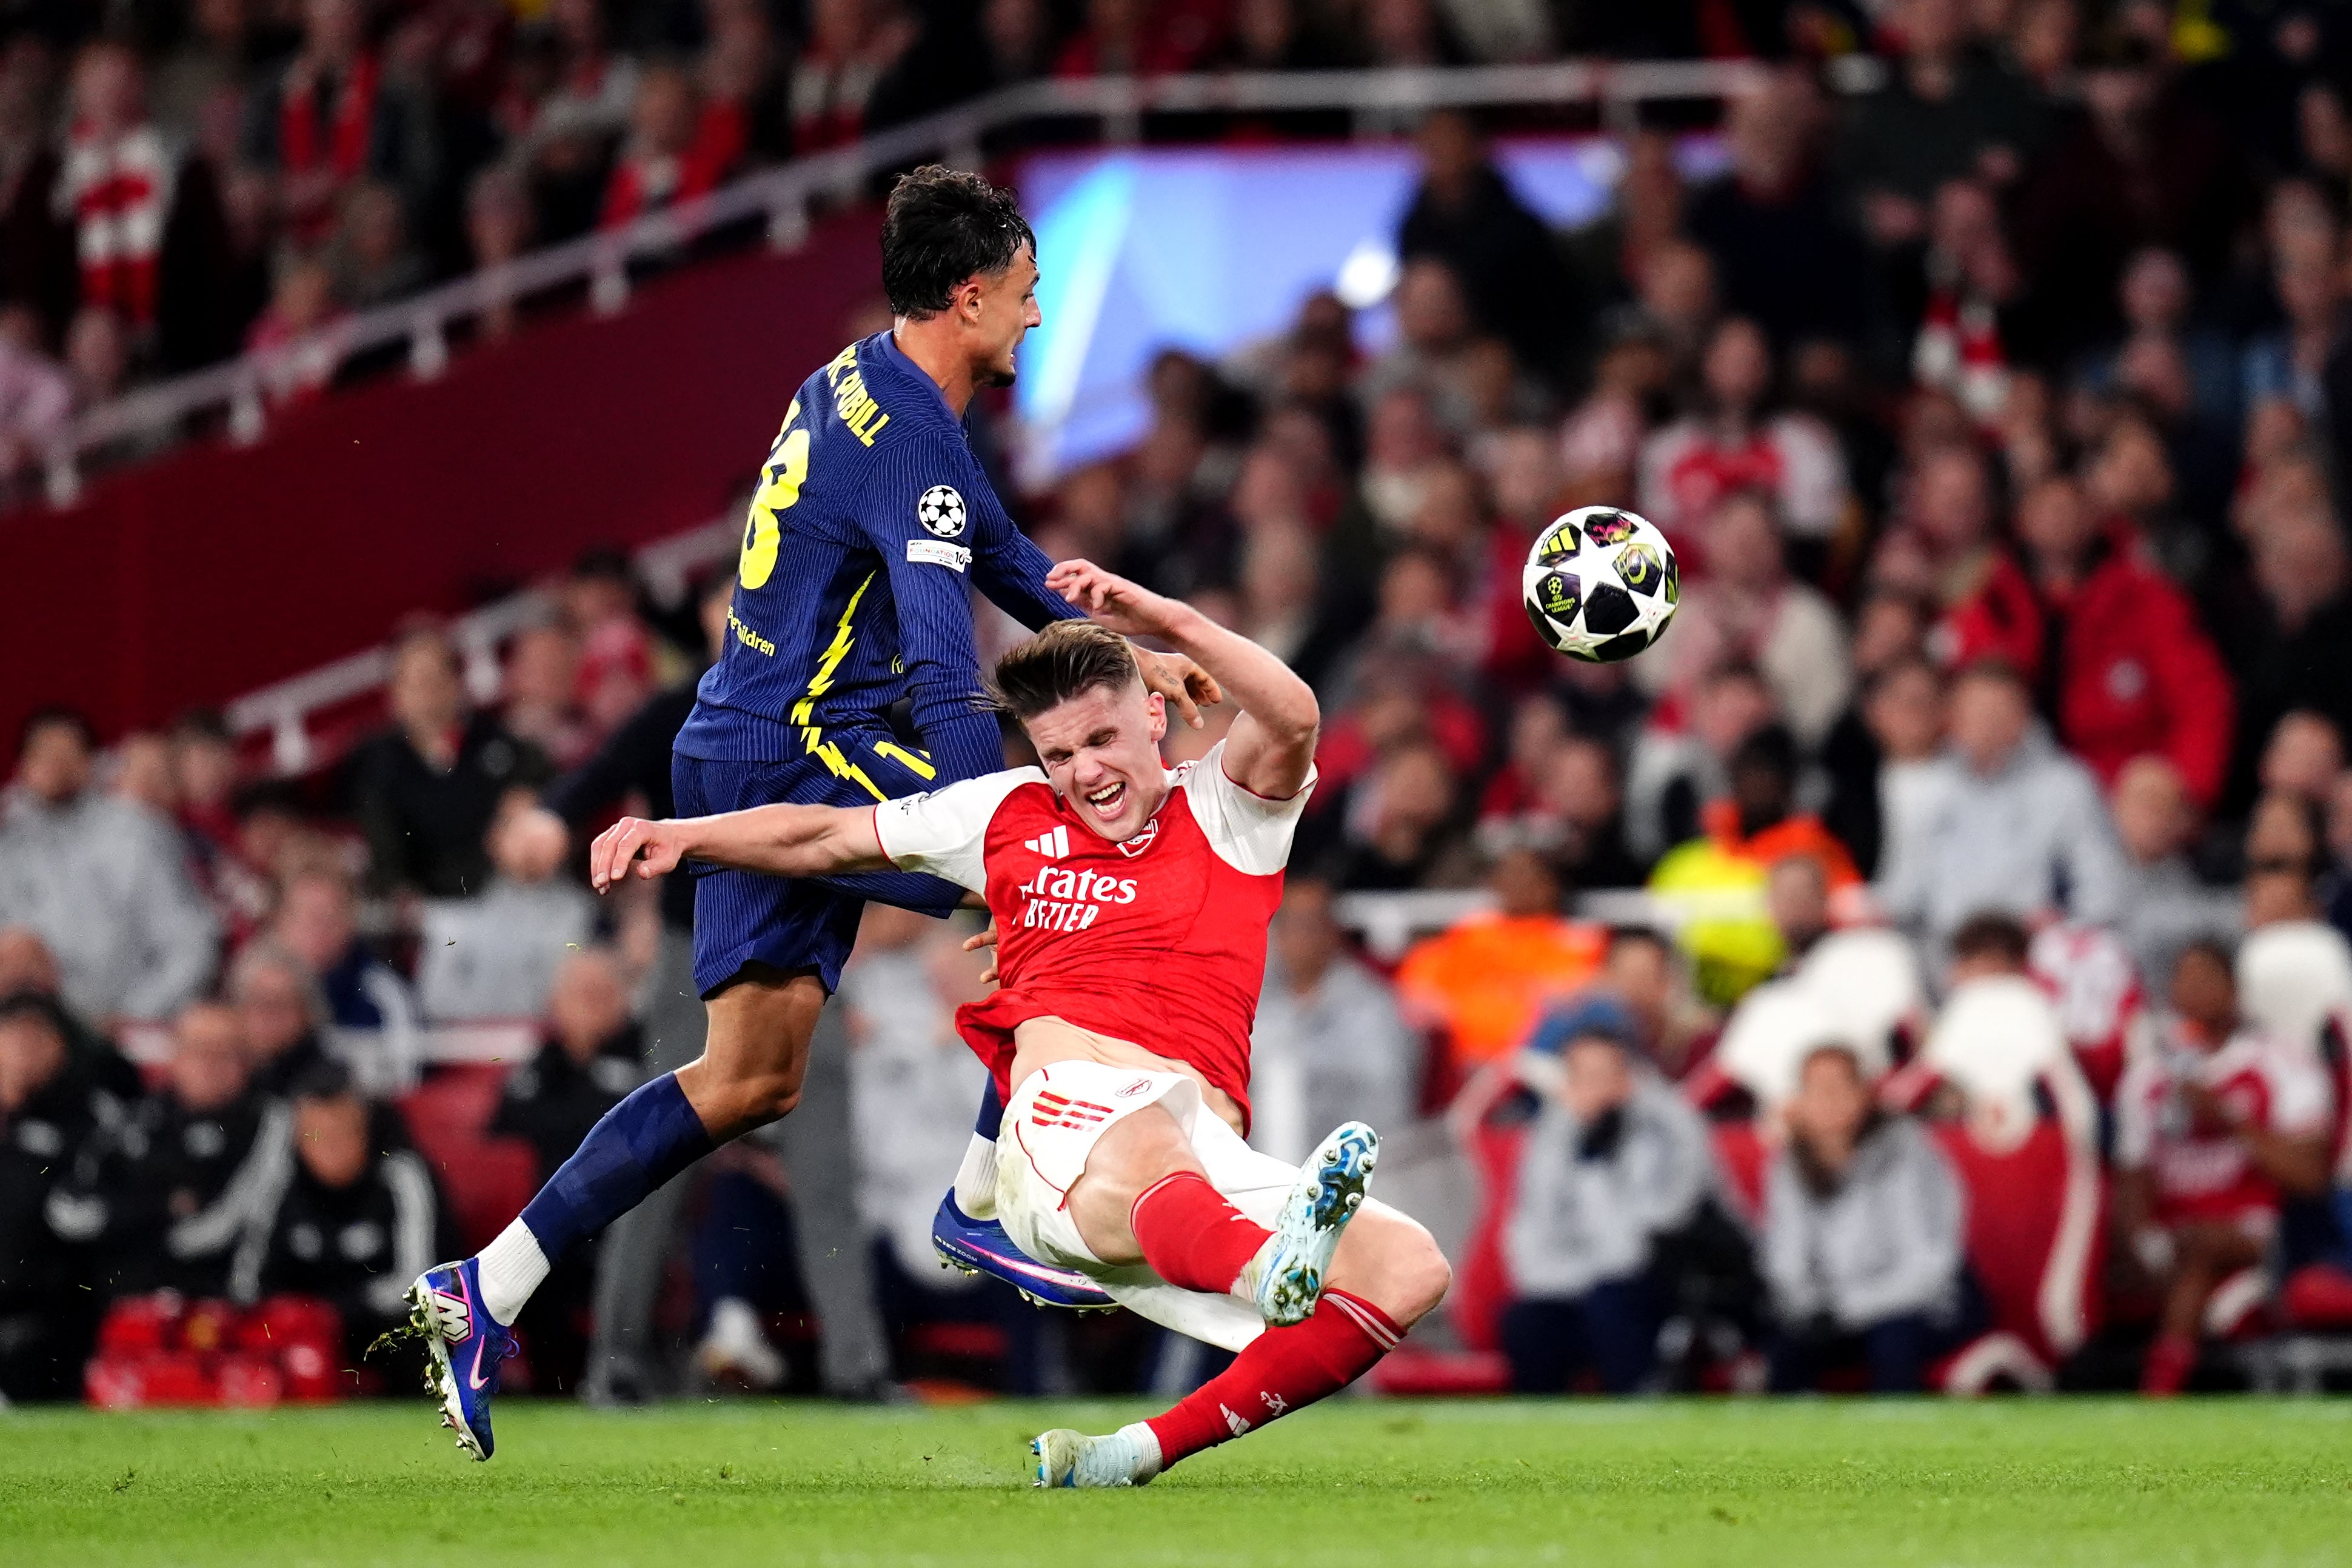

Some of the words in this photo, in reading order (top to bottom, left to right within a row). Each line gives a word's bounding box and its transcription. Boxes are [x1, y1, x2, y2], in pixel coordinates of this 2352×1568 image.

[826, 342, 858, 387] RC
[834, 370, 890, 447] PUBILL
[910, 548, 954, 558] FOUNDATION
[1545, 597, 1575, 609] CHAMPIONS
[737, 618, 775, 656] hildren
[874, 741, 937, 781] 1
[1018, 865, 1138, 904] rates
[1024, 898, 1099, 932] BETTER
[957, 1249, 978, 1263] ZOOM
